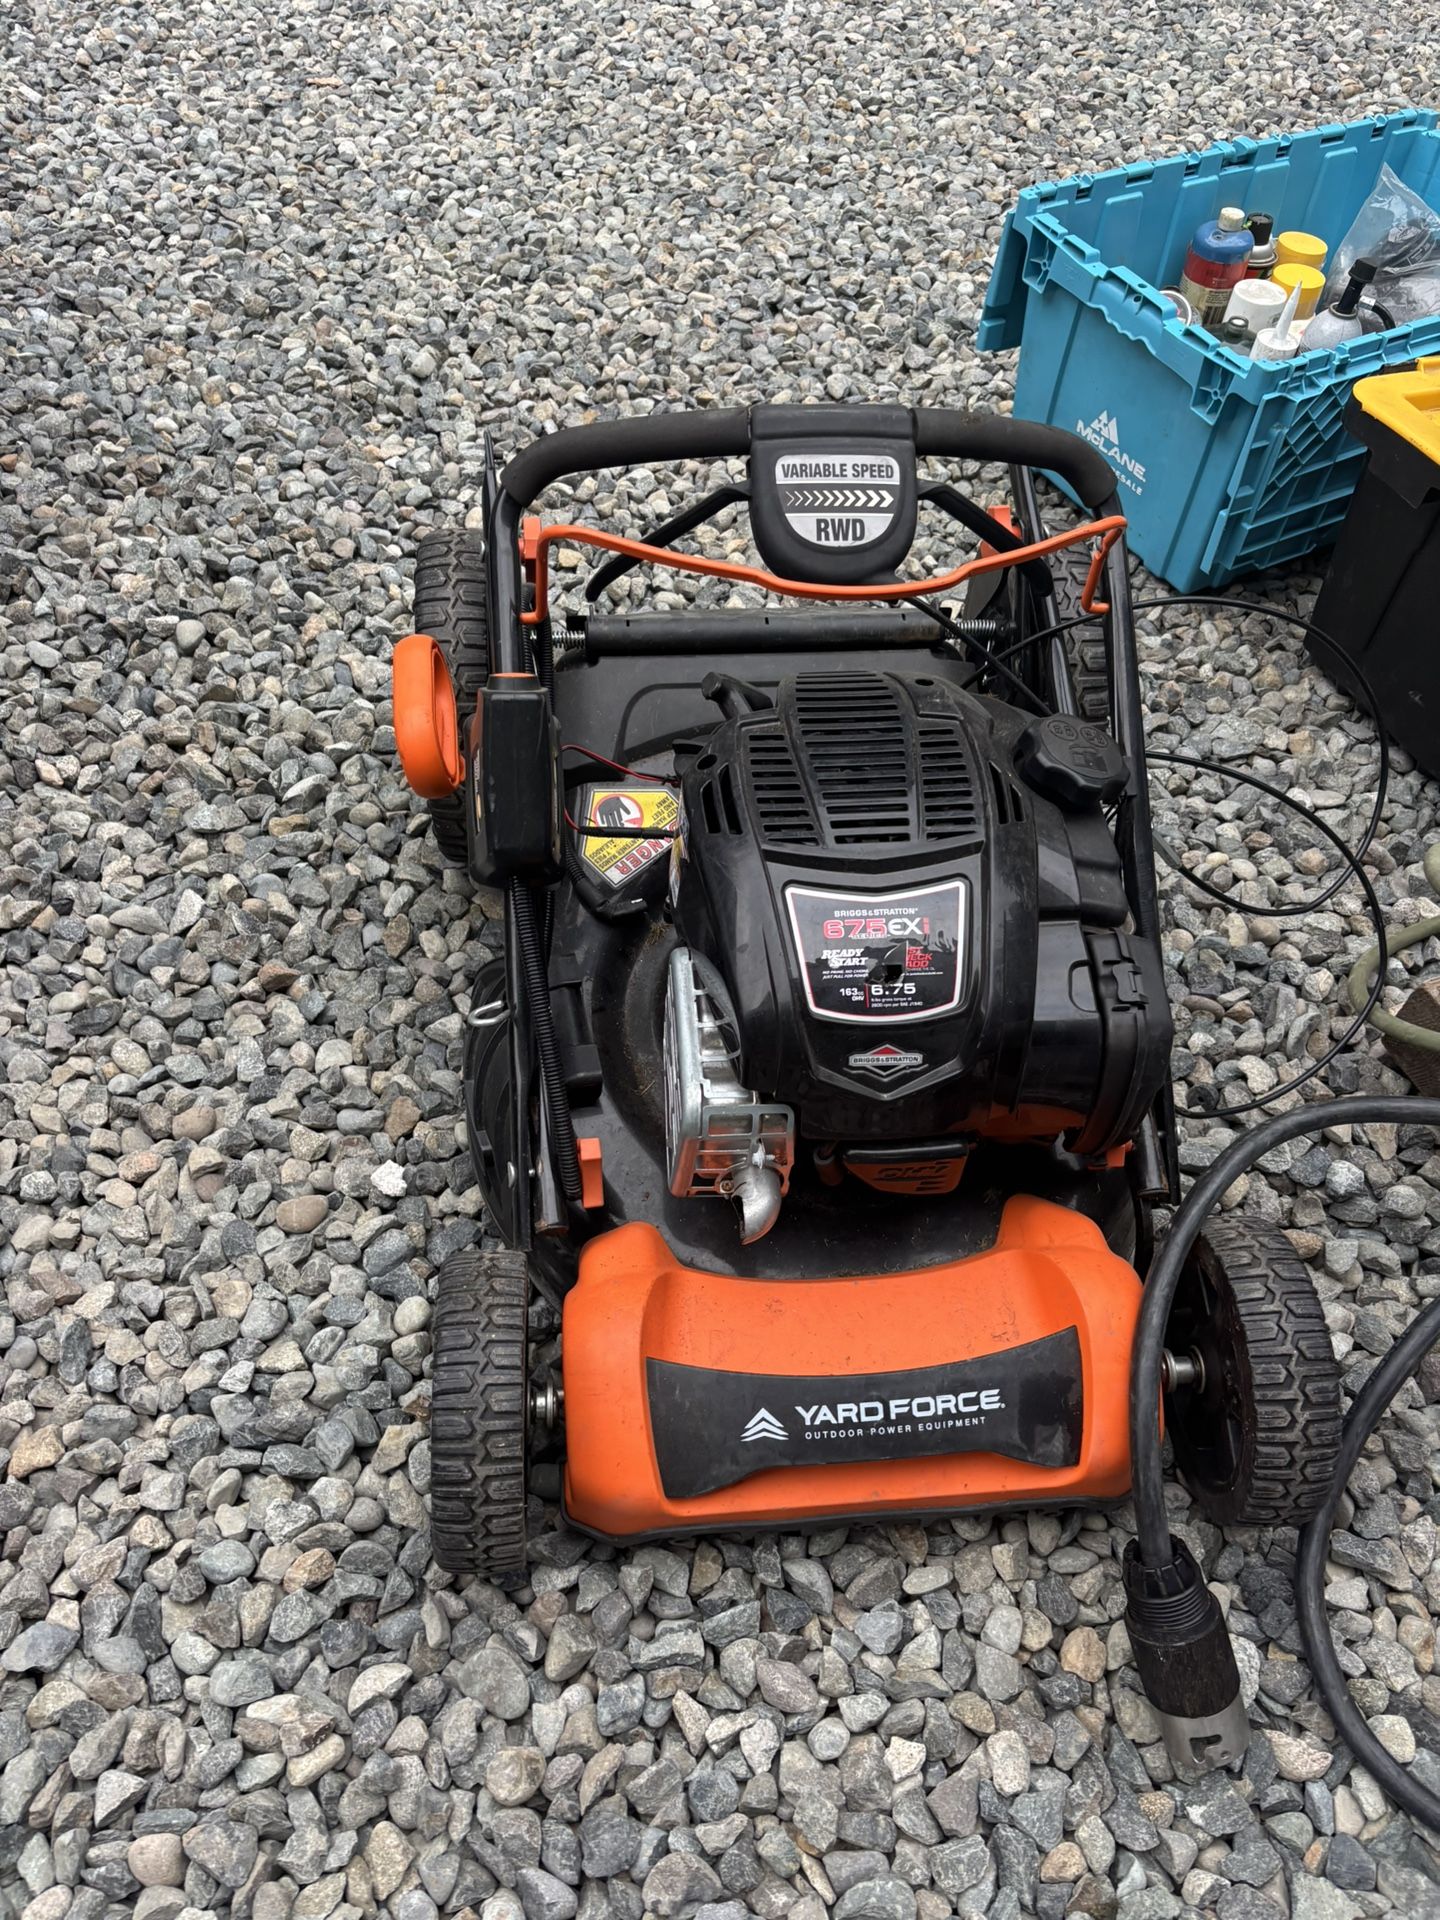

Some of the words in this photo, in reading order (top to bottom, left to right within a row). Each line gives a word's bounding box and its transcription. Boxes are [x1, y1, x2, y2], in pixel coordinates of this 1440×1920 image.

[781, 463, 848, 478] VARIABLE
[852, 463, 895, 478] SPEED
[1111, 466, 1143, 496] ESALE
[816, 518, 865, 541] RWD
[821, 949, 865, 959] READY
[829, 957, 869, 968] START
[871, 983, 916, 996] 6.75
[794, 1401, 885, 1427] YARD
[889, 1388, 1001, 1421] FORCE
[805, 1428, 864, 1441] OUTDOOR
[870, 1424, 912, 1436] POWER
[918, 1416, 987, 1432] EQUIPMENT
